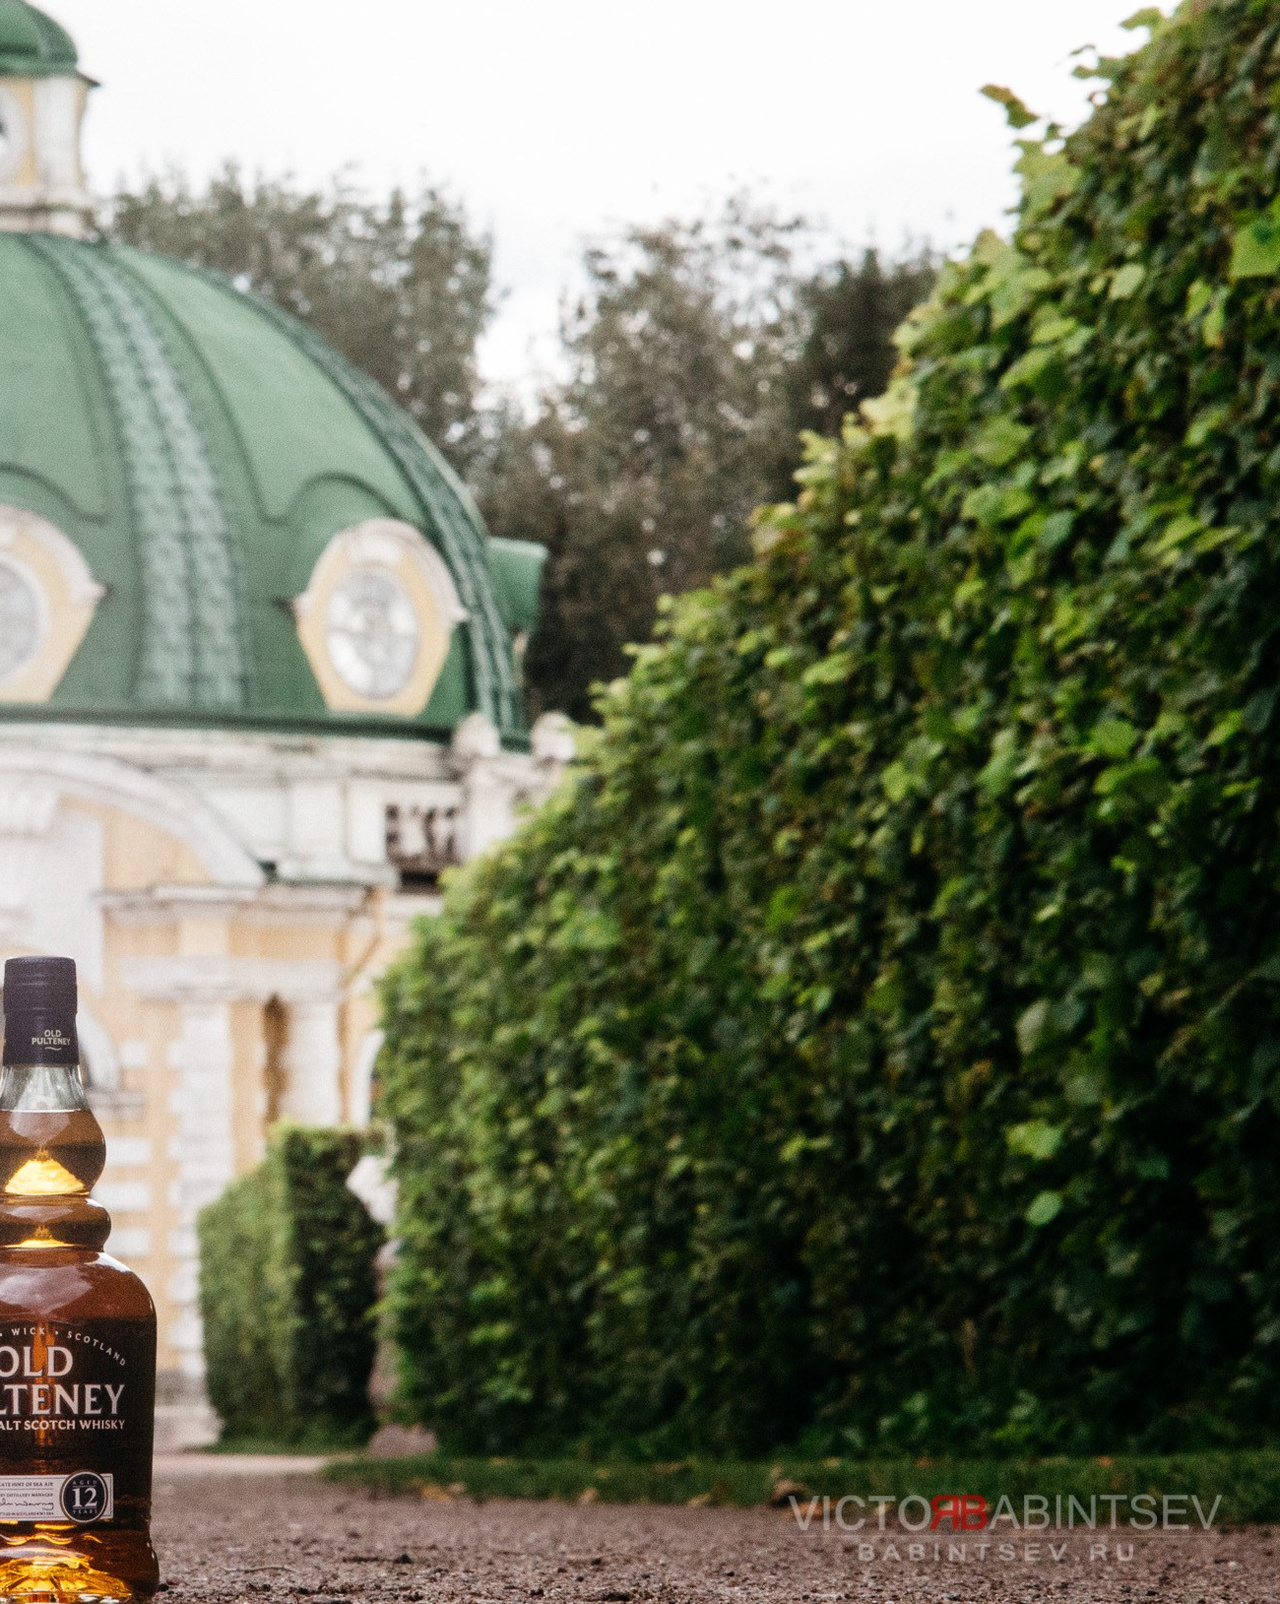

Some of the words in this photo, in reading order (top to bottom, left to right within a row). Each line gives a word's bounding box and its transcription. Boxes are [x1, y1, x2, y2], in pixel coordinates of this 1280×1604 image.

[44, 1029, 61, 1037] OLD
[31, 1037, 71, 1045] PULTENEY
[11, 1327, 46, 1336] WICK
[67, 1330, 126, 1366] SCOTLAND
[24, 1419, 76, 1431] SCOTCH
[79, 1419, 125, 1430] WHISKY
[72, 1487, 98, 1507] 12
